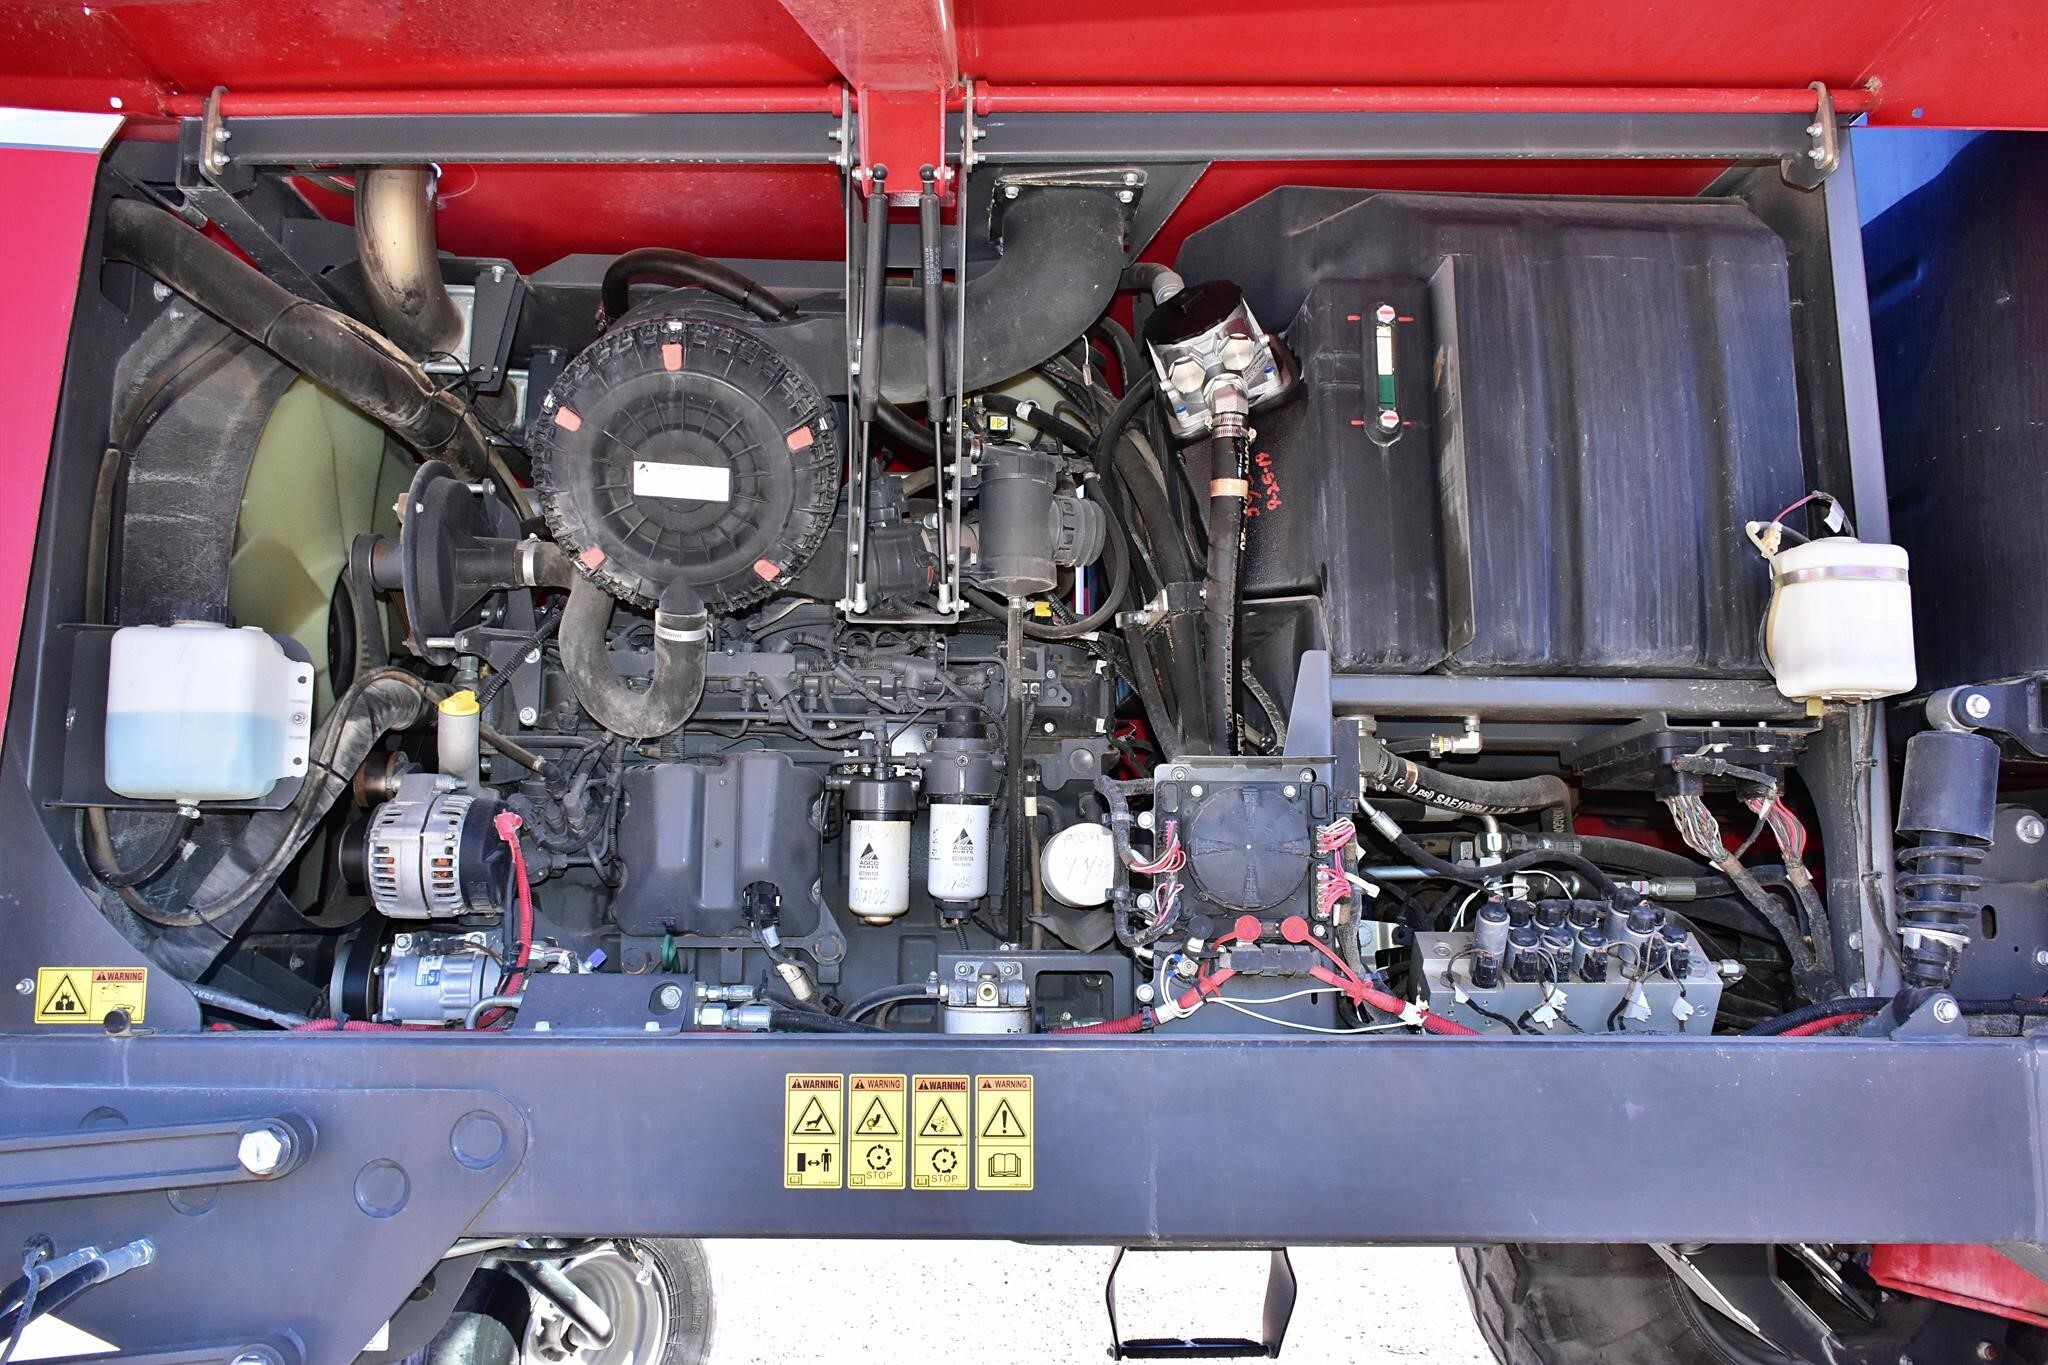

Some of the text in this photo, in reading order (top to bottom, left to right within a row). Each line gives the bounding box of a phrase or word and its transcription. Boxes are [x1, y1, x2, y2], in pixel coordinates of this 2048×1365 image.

[107, 972, 143, 981] WARNING
[802, 1079, 839, 1089] WARNING
[867, 1079, 901, 1089] WARNING
[928, 1080, 966, 1091] WARNING
[994, 1080, 1027, 1089] WARNING
[866, 1171, 893, 1180] STOP
[931, 1174, 958, 1183] STOP
